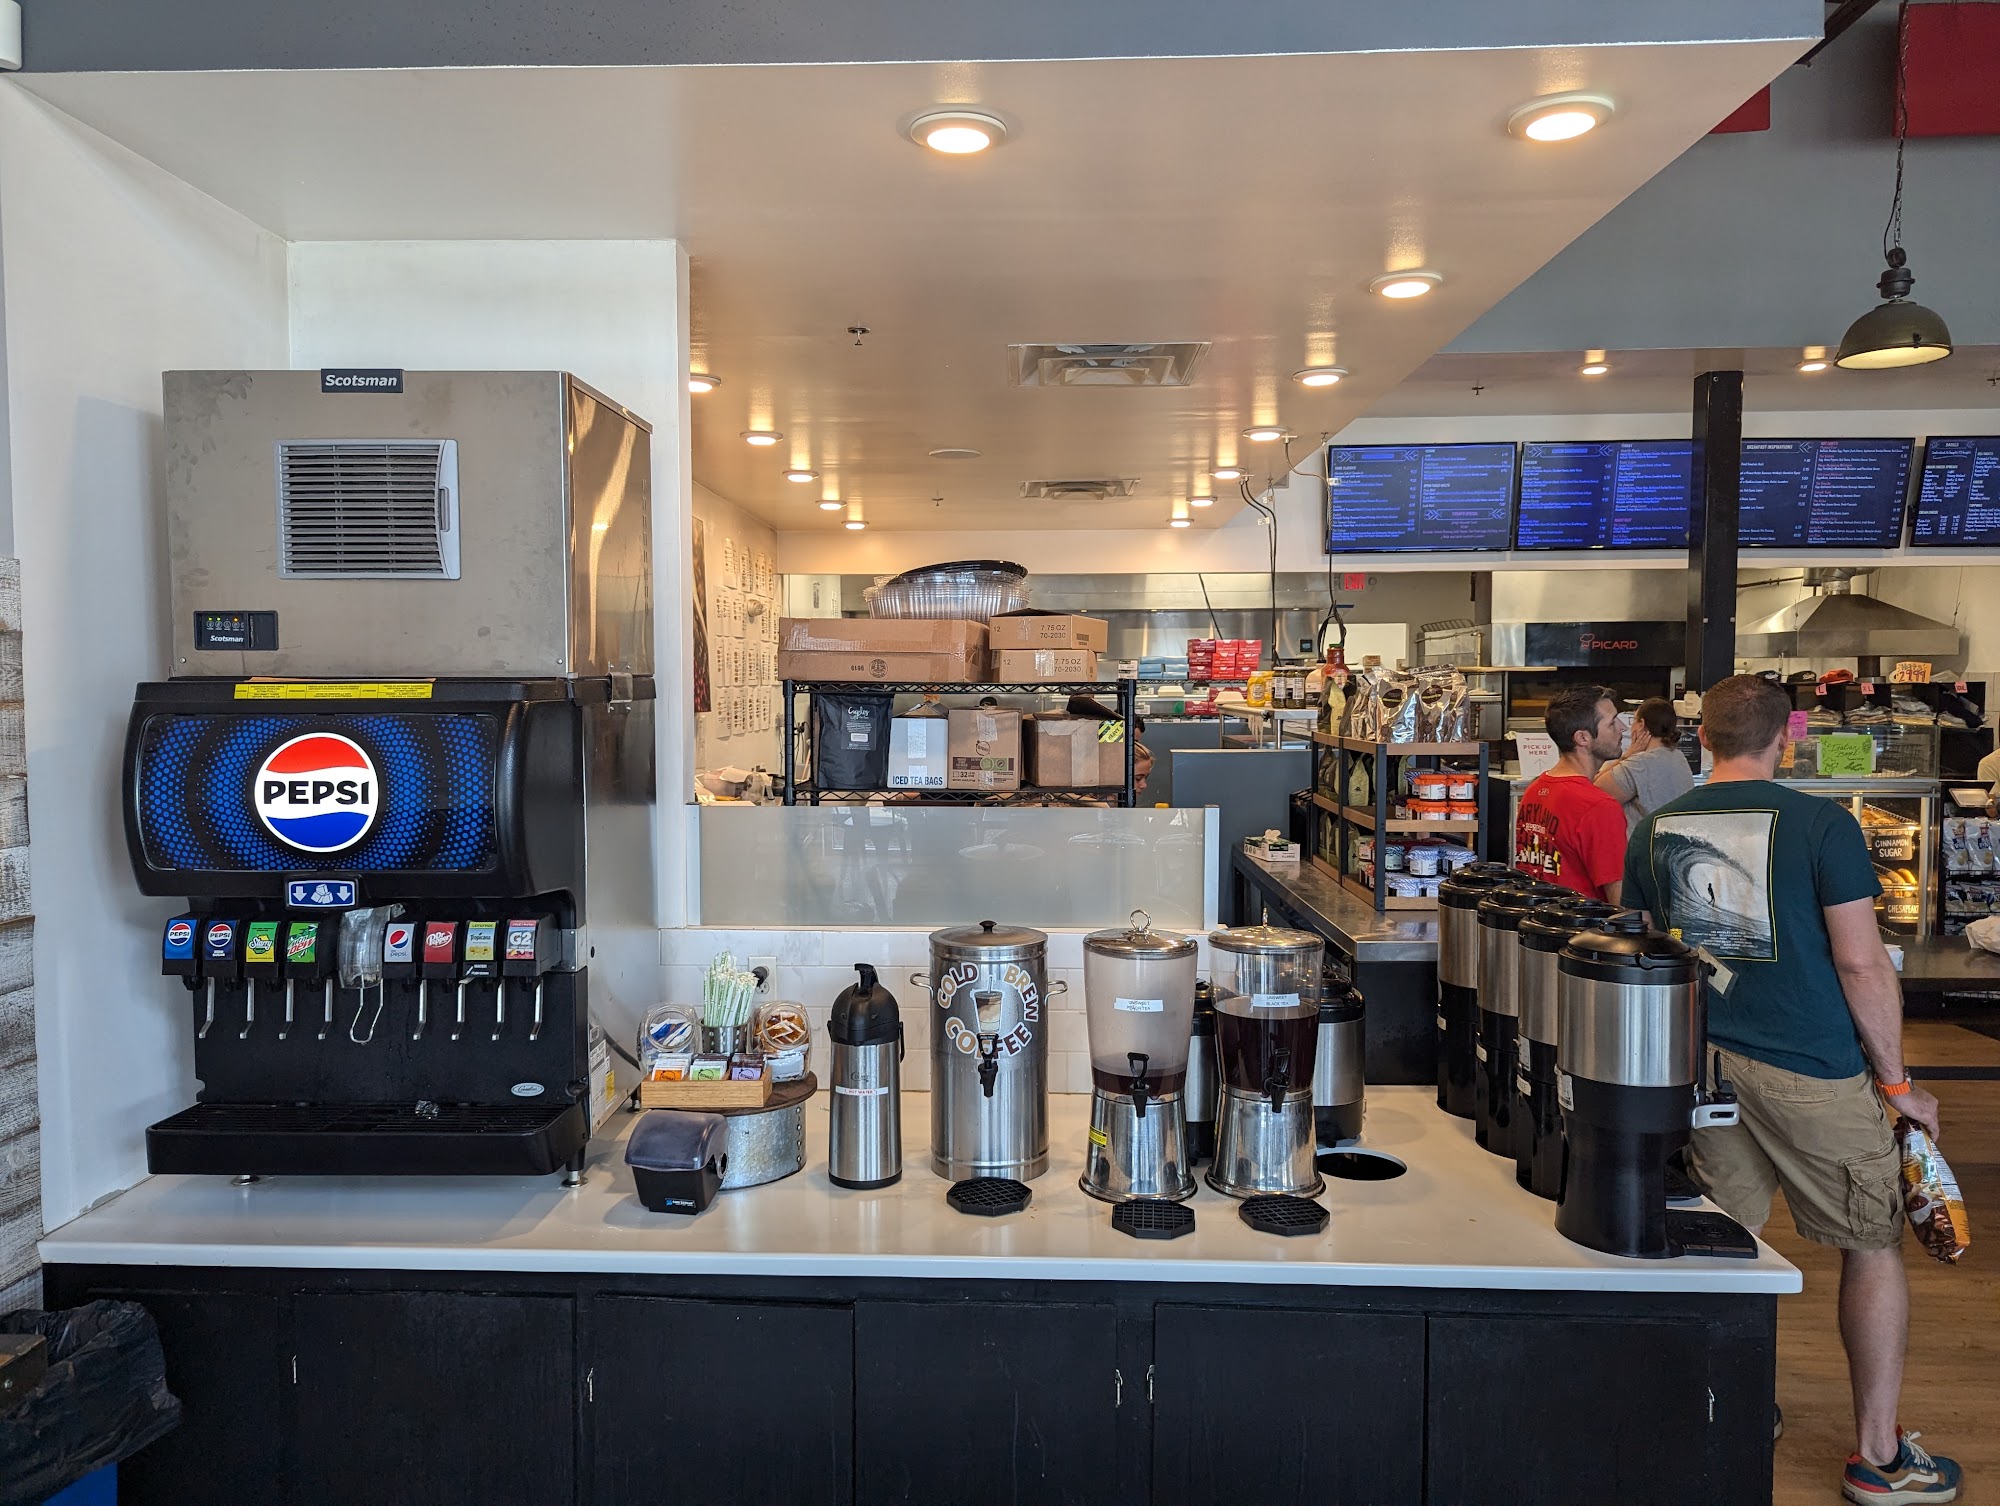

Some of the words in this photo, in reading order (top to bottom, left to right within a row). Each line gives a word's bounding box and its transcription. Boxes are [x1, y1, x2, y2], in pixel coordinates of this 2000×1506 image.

[325, 374, 398, 387] Scotsman
[210, 635, 244, 643] Scotsman
[1591, 640, 1638, 650] PICARD
[892, 775, 909, 785] ICED
[909, 776, 923, 785] TEA
[924, 776, 943, 786] BAGS
[263, 780, 370, 805] PEPSI
[1874, 838, 1910, 848] CINNAMON
[1879, 848, 1903, 858] SUGAR
[470, 933, 491, 941] Tropicana
[509, 931, 533, 946] G2
[938, 962, 979, 1008] COLD
[1003, 963, 1038, 1022] BREW
